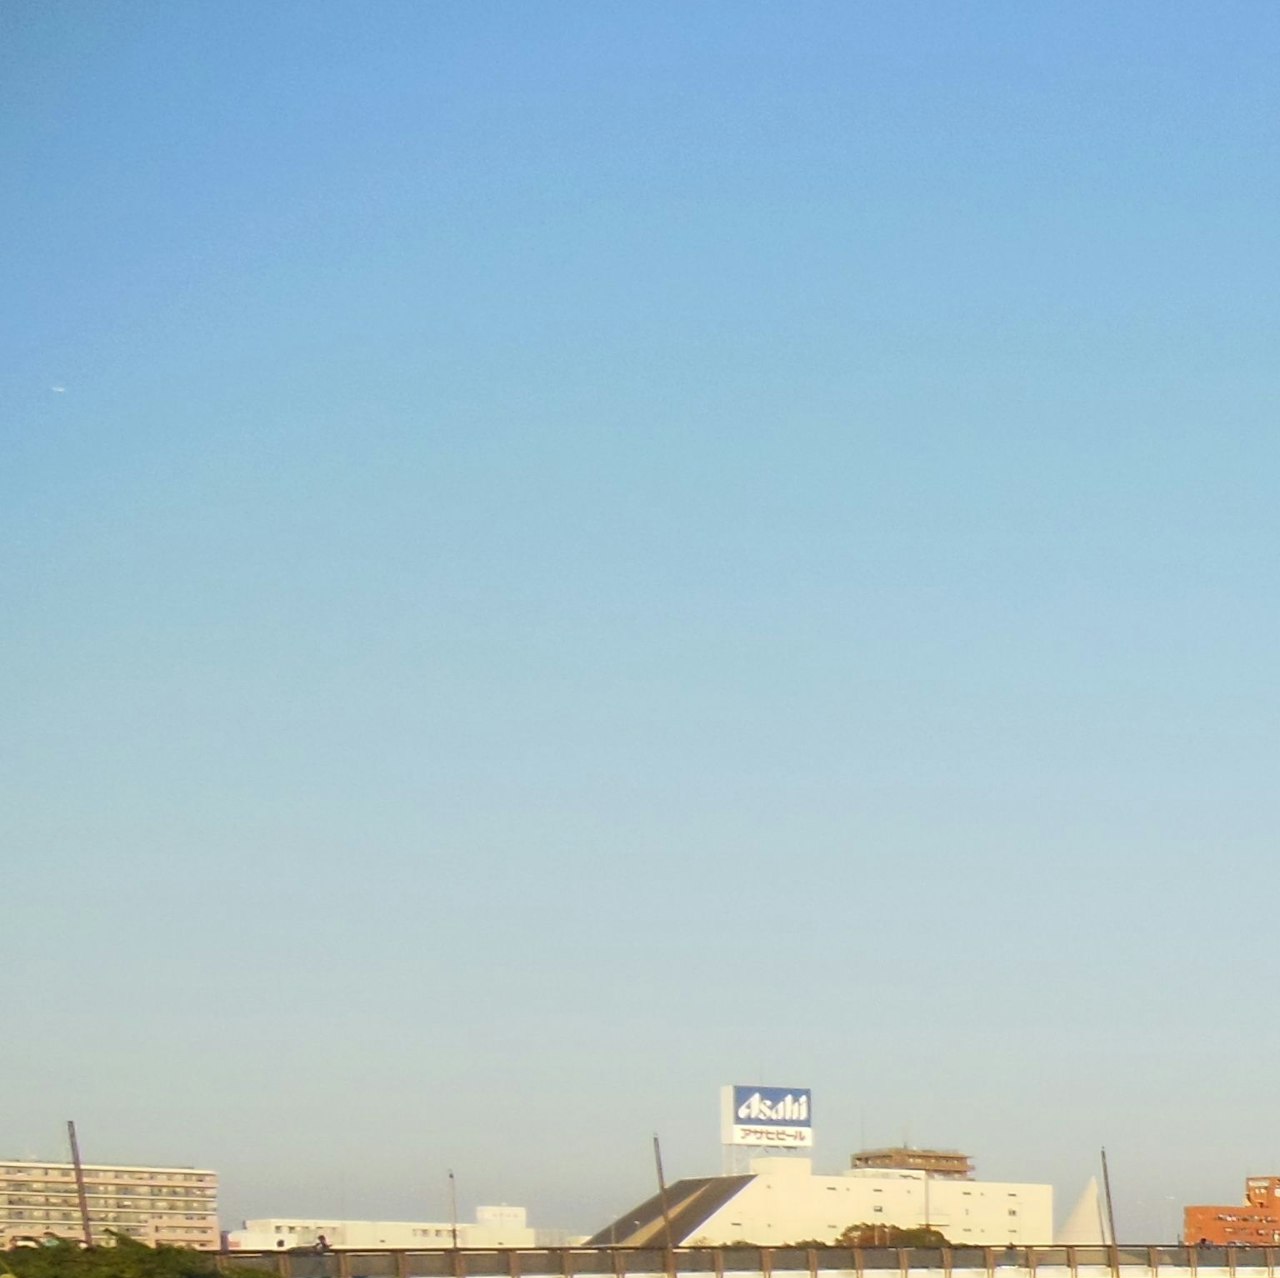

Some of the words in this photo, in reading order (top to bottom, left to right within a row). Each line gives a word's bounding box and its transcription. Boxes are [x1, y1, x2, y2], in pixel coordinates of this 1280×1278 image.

[738, 1092, 808, 1120] Asahi
[740, 1128, 806, 1141] アサヒビール
